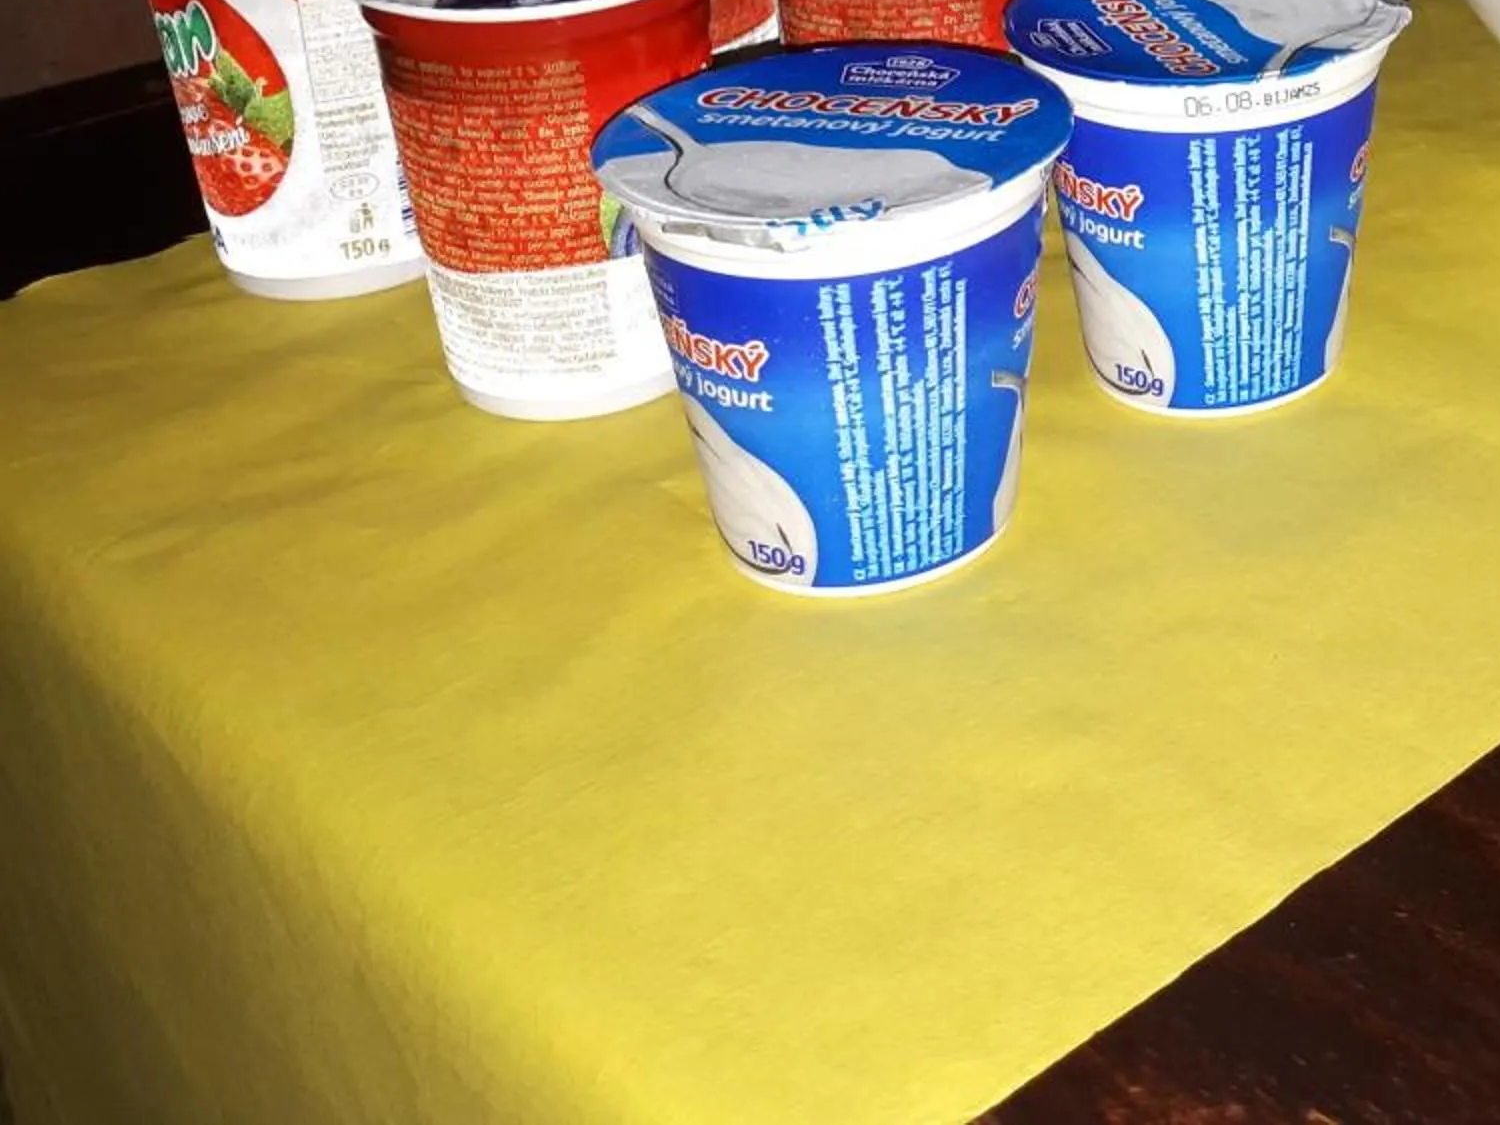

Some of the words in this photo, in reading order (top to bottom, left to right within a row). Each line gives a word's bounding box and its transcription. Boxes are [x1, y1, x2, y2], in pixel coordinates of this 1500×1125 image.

[698, 87, 1039, 126] CHOCEŇSKÝ
[698, 111, 895, 136] smetanový
[894, 121, 1007, 143] jogurt
[1079, 210, 1146, 250] jogurt
[696, 371, 774, 413] jogurt
